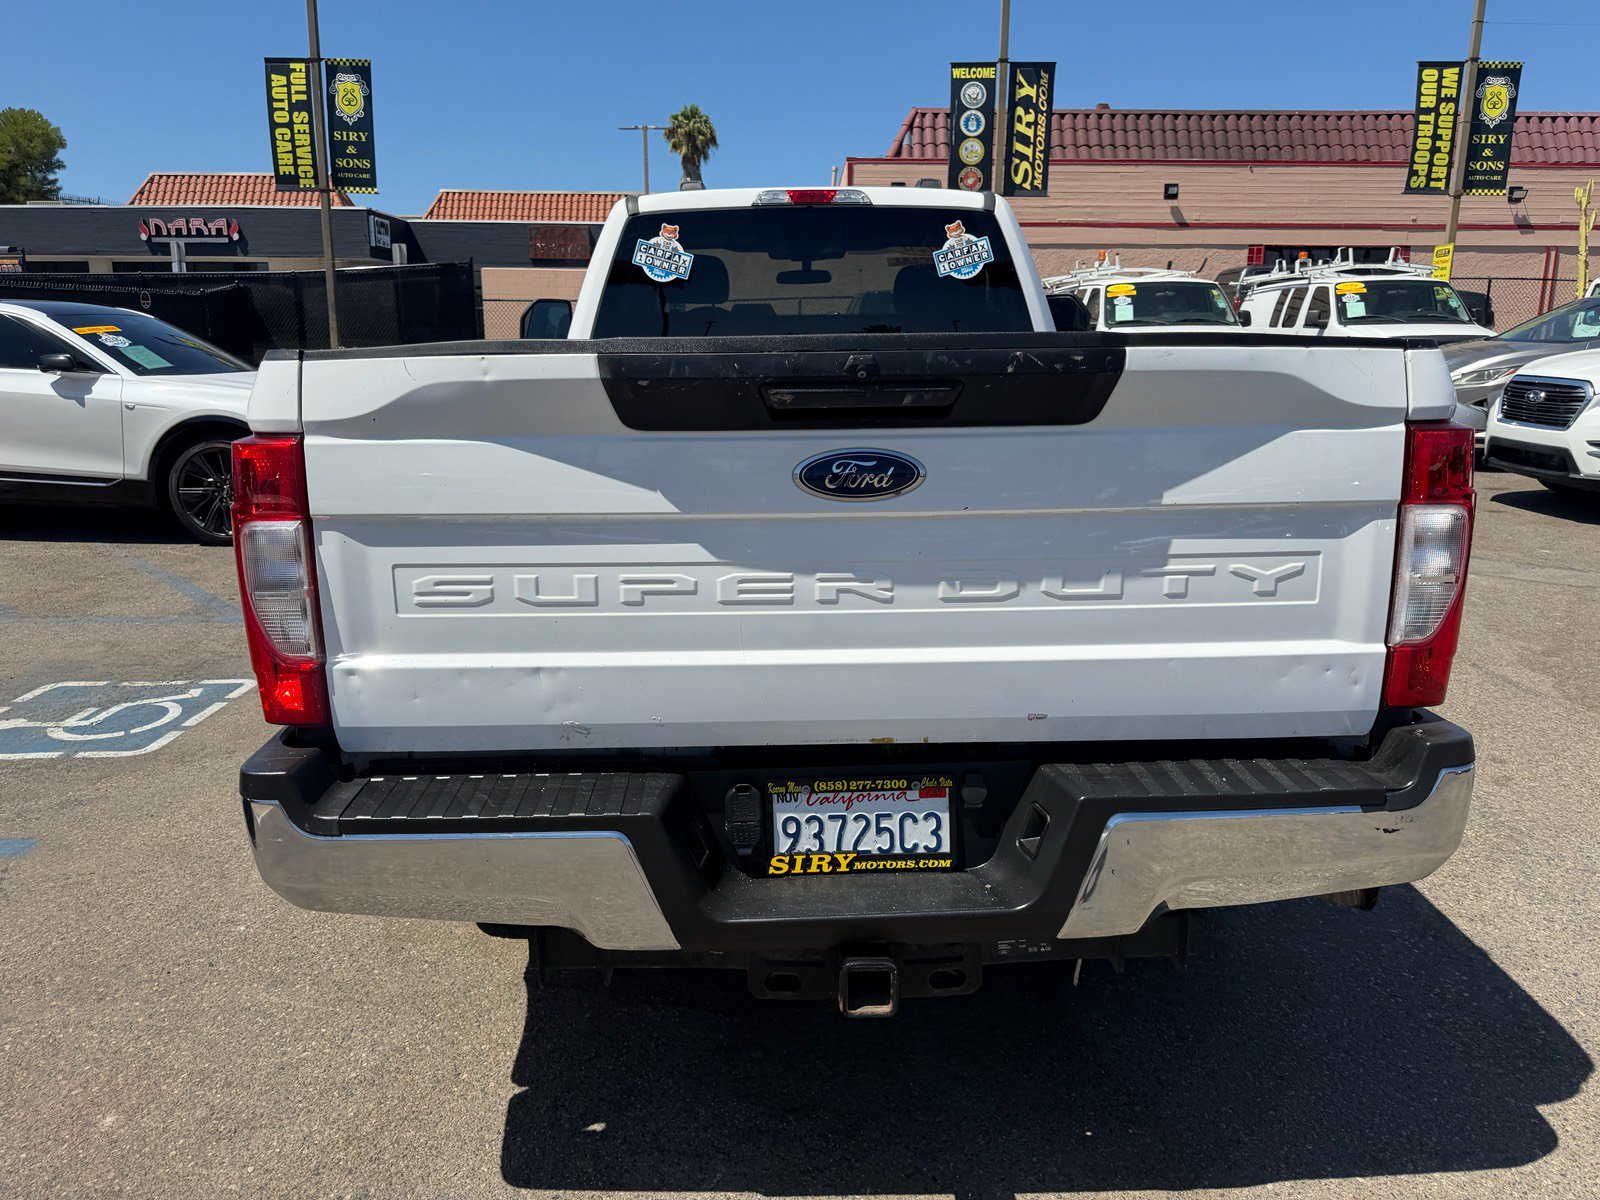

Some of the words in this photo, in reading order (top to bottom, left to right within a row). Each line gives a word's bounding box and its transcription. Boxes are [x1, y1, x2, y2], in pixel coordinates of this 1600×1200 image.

[290, 62, 307, 103] FULL
[952, 67, 996, 79] WELCOME
[1441, 67, 1460, 98] WE
[271, 73, 290, 123] AUTO
[1420, 68, 1438, 108] OUR
[333, 131, 368, 141] SIRY
[1011, 68, 1037, 190] SIRY
[1034, 69, 1049, 190] MOTORS.COM
[1471, 134, 1508, 144] SIRY
[275, 127, 294, 175] CARE
[293, 111, 315, 188] SERVICE
[346, 145, 357, 154] &
[1410, 112, 1435, 189] TROOPS
[1430, 102, 1455, 190] SUPPORT
[1482, 148, 1493, 157] &
[335, 158, 371, 169] SONS
[1468, 161, 1504, 171] SONS
[640, 245, 688, 265] CARFAX
[938, 244, 986, 261] CARFAX
[949, 251, 988, 269] OWNER
[645, 257, 686, 274] OWNER
[825, 460, 894, 488] Ford
[412, 572, 894, 607] SUPER
[938, 562, 1306, 603] DUTY
[814, 780, 848, 792] (858)
[850, 779, 907, 790] 277-7300
[806, 790, 920, 810] California
[781, 811, 942, 853] 93725C3
[768, 852, 857, 874] SIRY
[853, 859, 952, 870] MOTORS.COM
